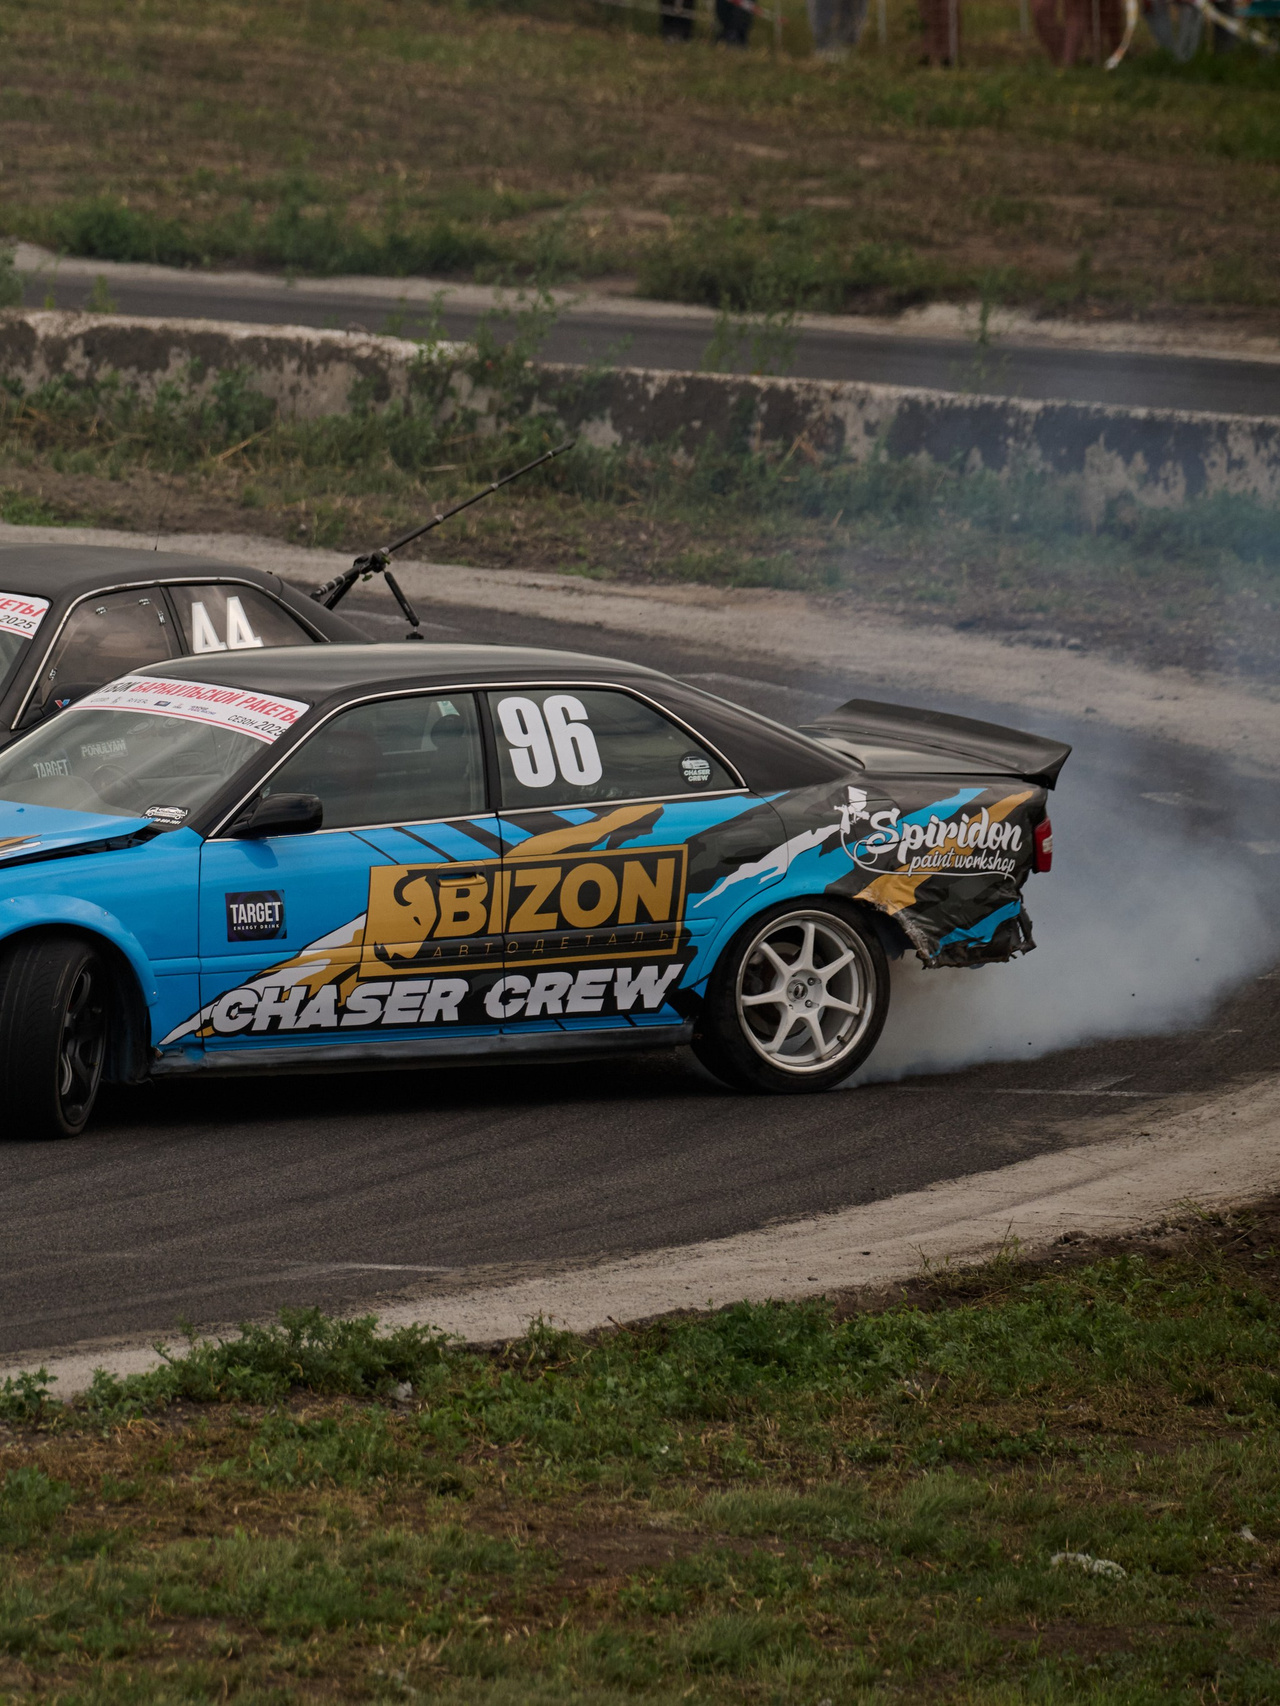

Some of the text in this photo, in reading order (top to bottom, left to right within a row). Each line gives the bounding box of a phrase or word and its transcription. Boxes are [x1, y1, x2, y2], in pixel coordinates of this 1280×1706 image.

[192, 596, 264, 654] 44
[130, 682, 247, 706] БАРНАУЛЬСКОЙ
[228, 715, 255, 727] СЕЗОН
[497, 695, 603, 788] 96
[33, 759, 69, 778] TARGET
[865, 807, 1023, 864] Spiridon
[907, 848, 1016, 880] paint workshop
[230, 901, 281, 923] TARGET
[433, 858, 676, 938] BIZON
[433, 930, 670, 958] АВТОДЕТАЛЬ
[213, 963, 685, 1034] CHASER CREW
